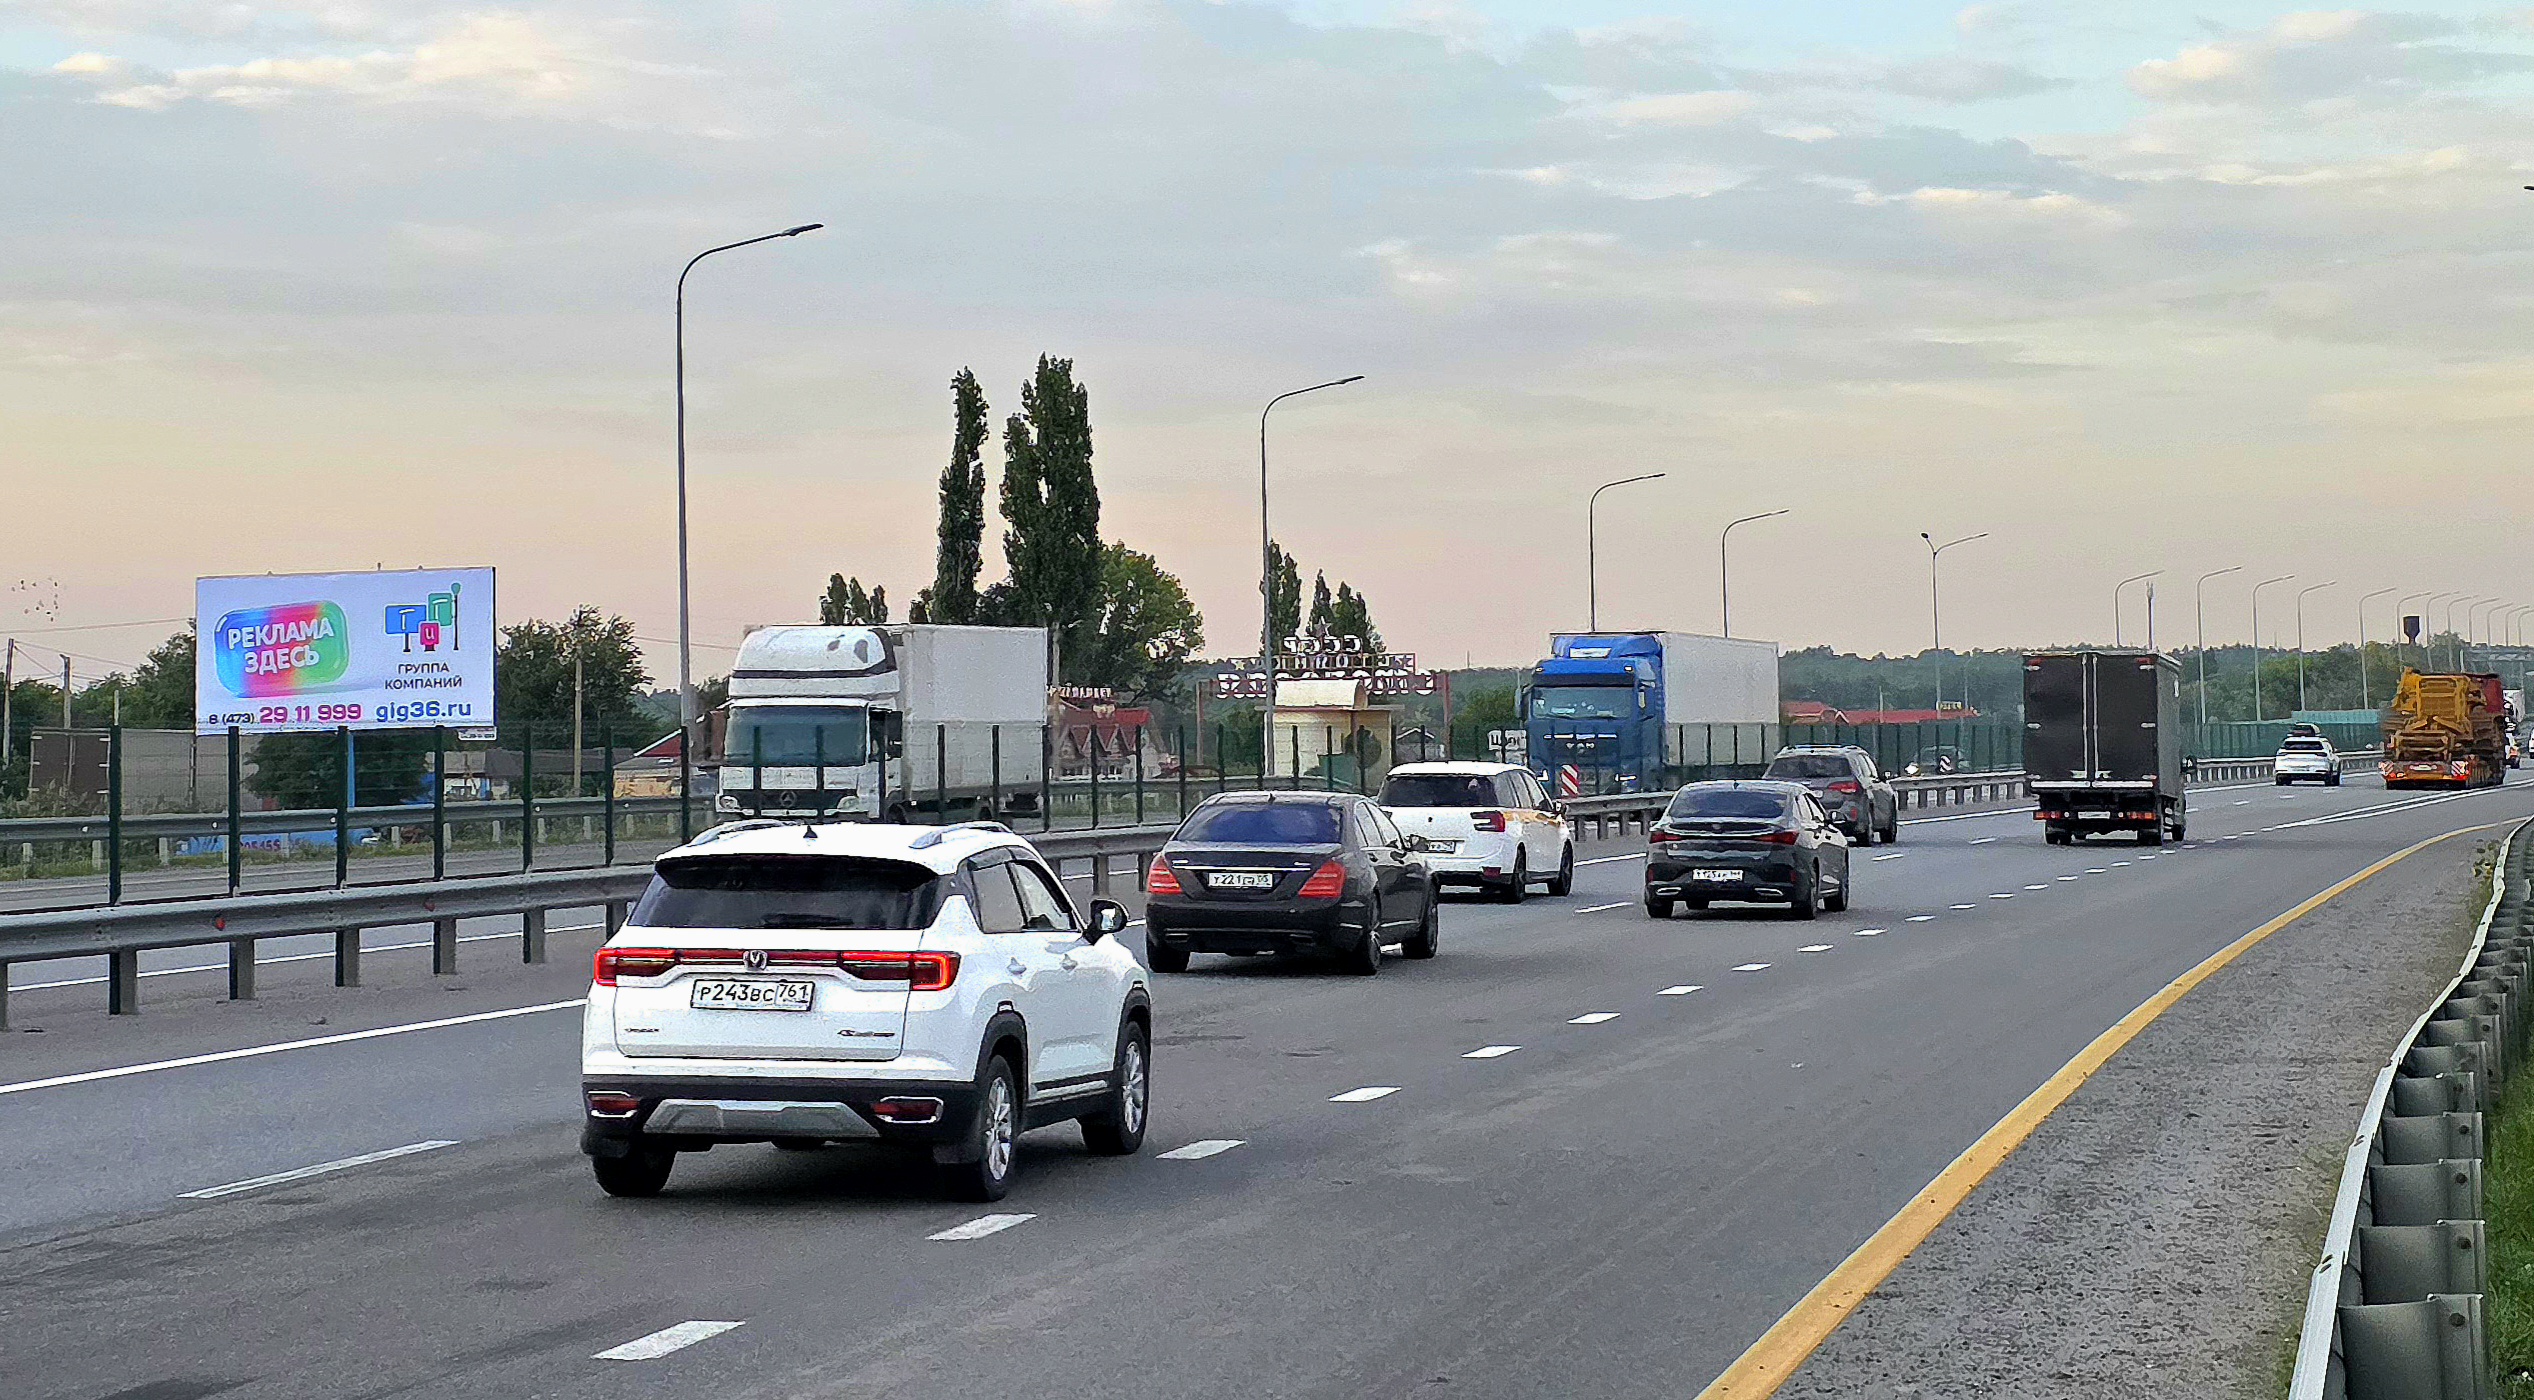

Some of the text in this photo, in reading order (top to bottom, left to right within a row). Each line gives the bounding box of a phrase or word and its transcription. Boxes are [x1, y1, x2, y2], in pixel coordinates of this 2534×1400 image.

[228, 617, 335, 649] РЕКЛАМА
[244, 645, 320, 675] ЗДЕСЬ
[398, 662, 450, 675] ГРУППА
[385, 675, 462, 690] КОМПАНИЙ
[222, 713, 255, 726] (473)
[259, 706, 288, 724] 29
[295, 705, 311, 722] 11
[317, 704, 362, 721] 999
[376, 701, 471, 723] gig36.ru
